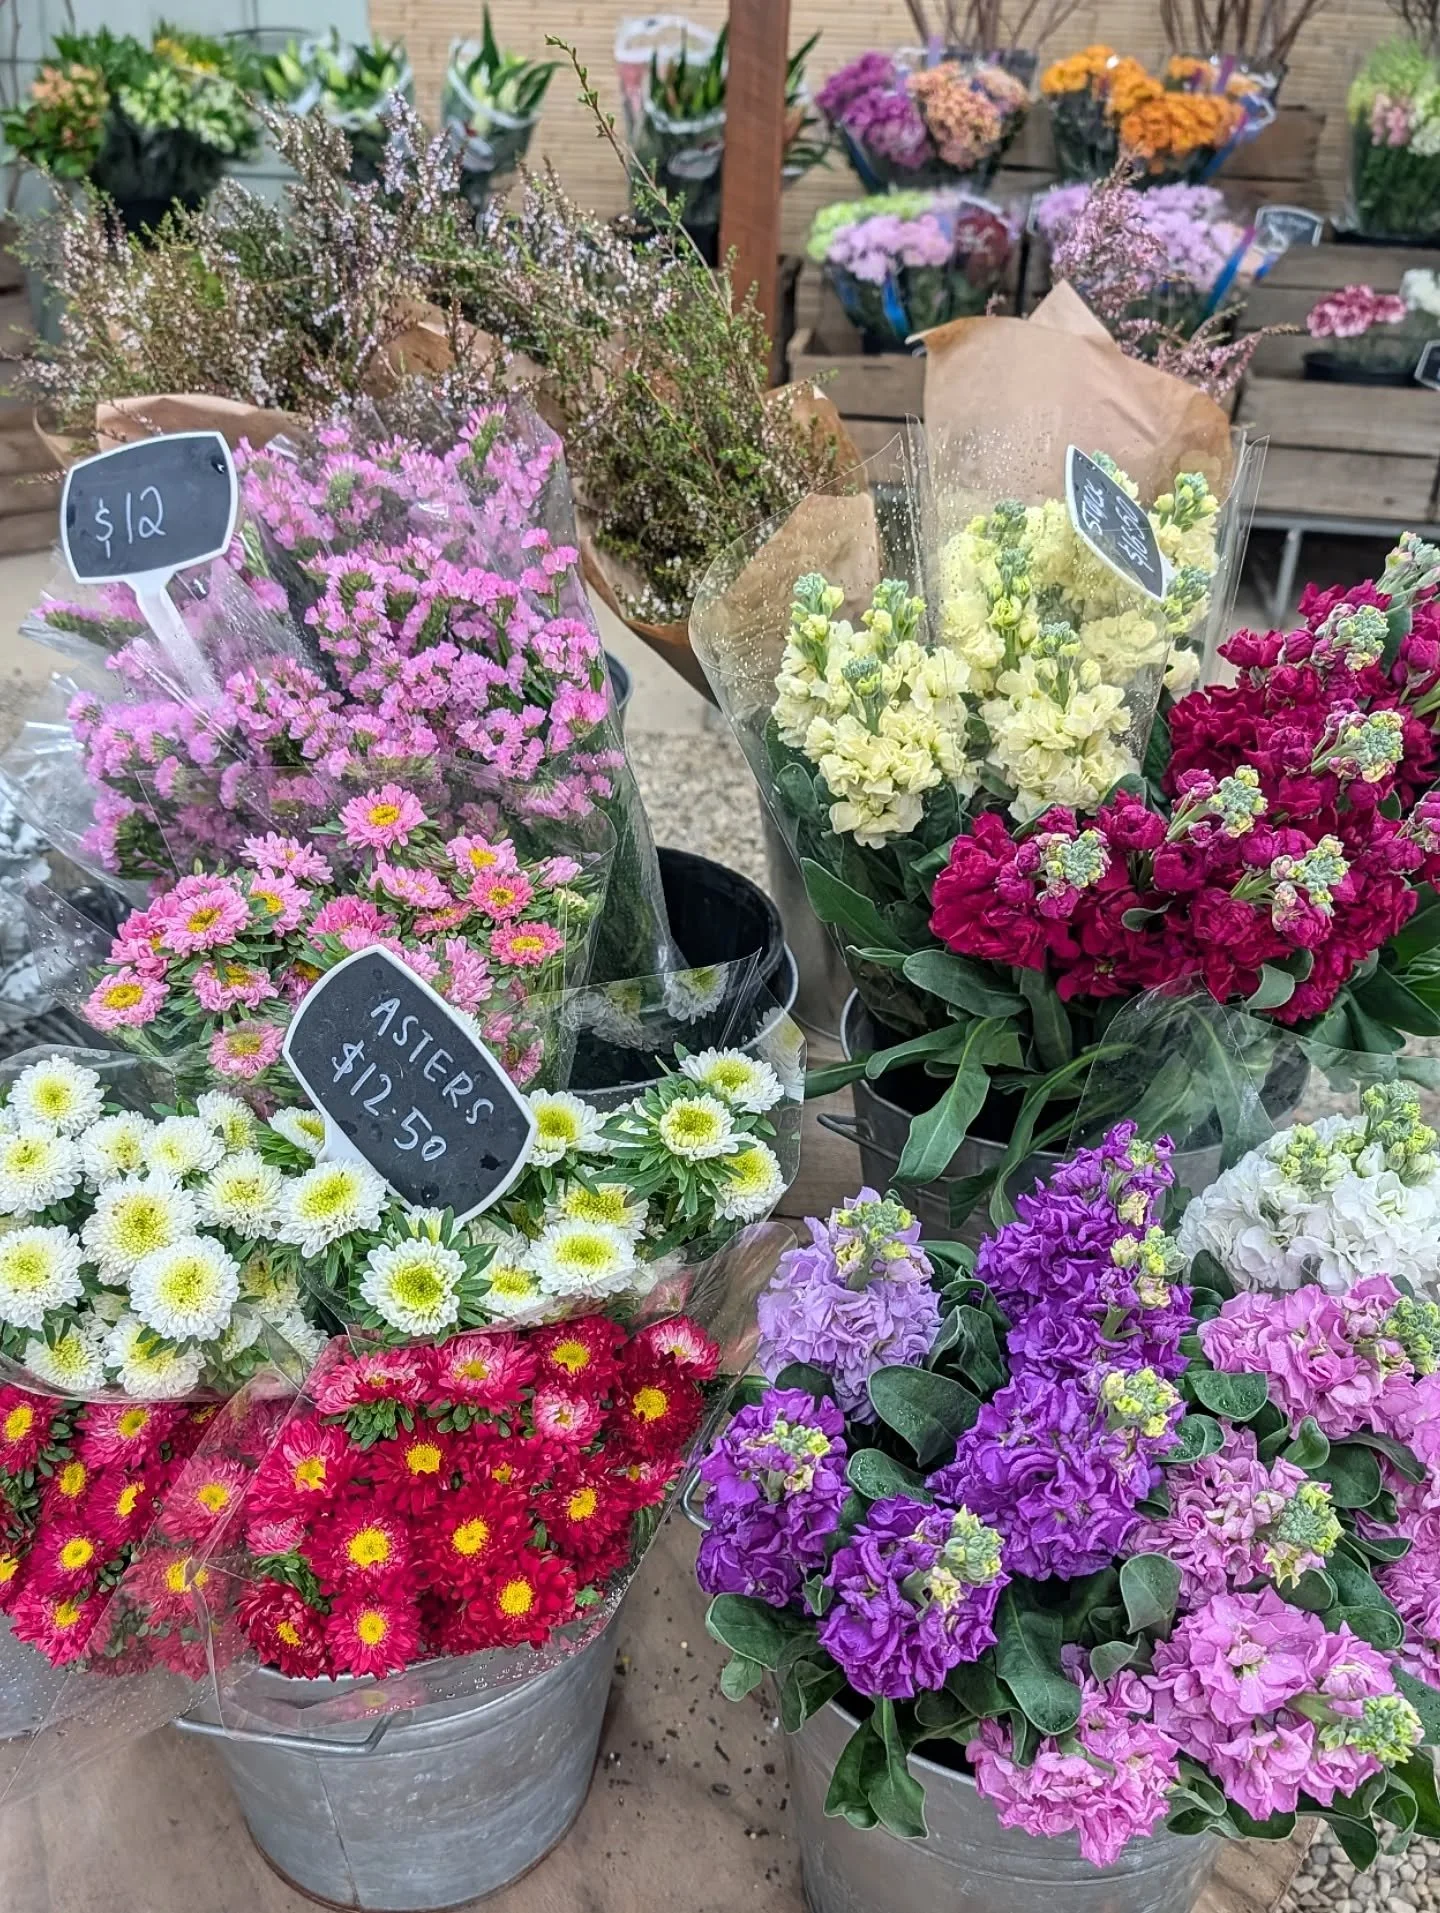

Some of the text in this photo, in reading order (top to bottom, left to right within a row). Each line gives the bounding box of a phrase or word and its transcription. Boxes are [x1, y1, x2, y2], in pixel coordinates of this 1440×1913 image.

[95, 485, 167, 559] $12
[1081, 478, 1109, 536] STOCK
[331, 1039, 447, 1162] $12.50
[370, 997, 495, 1125] ASTERS
